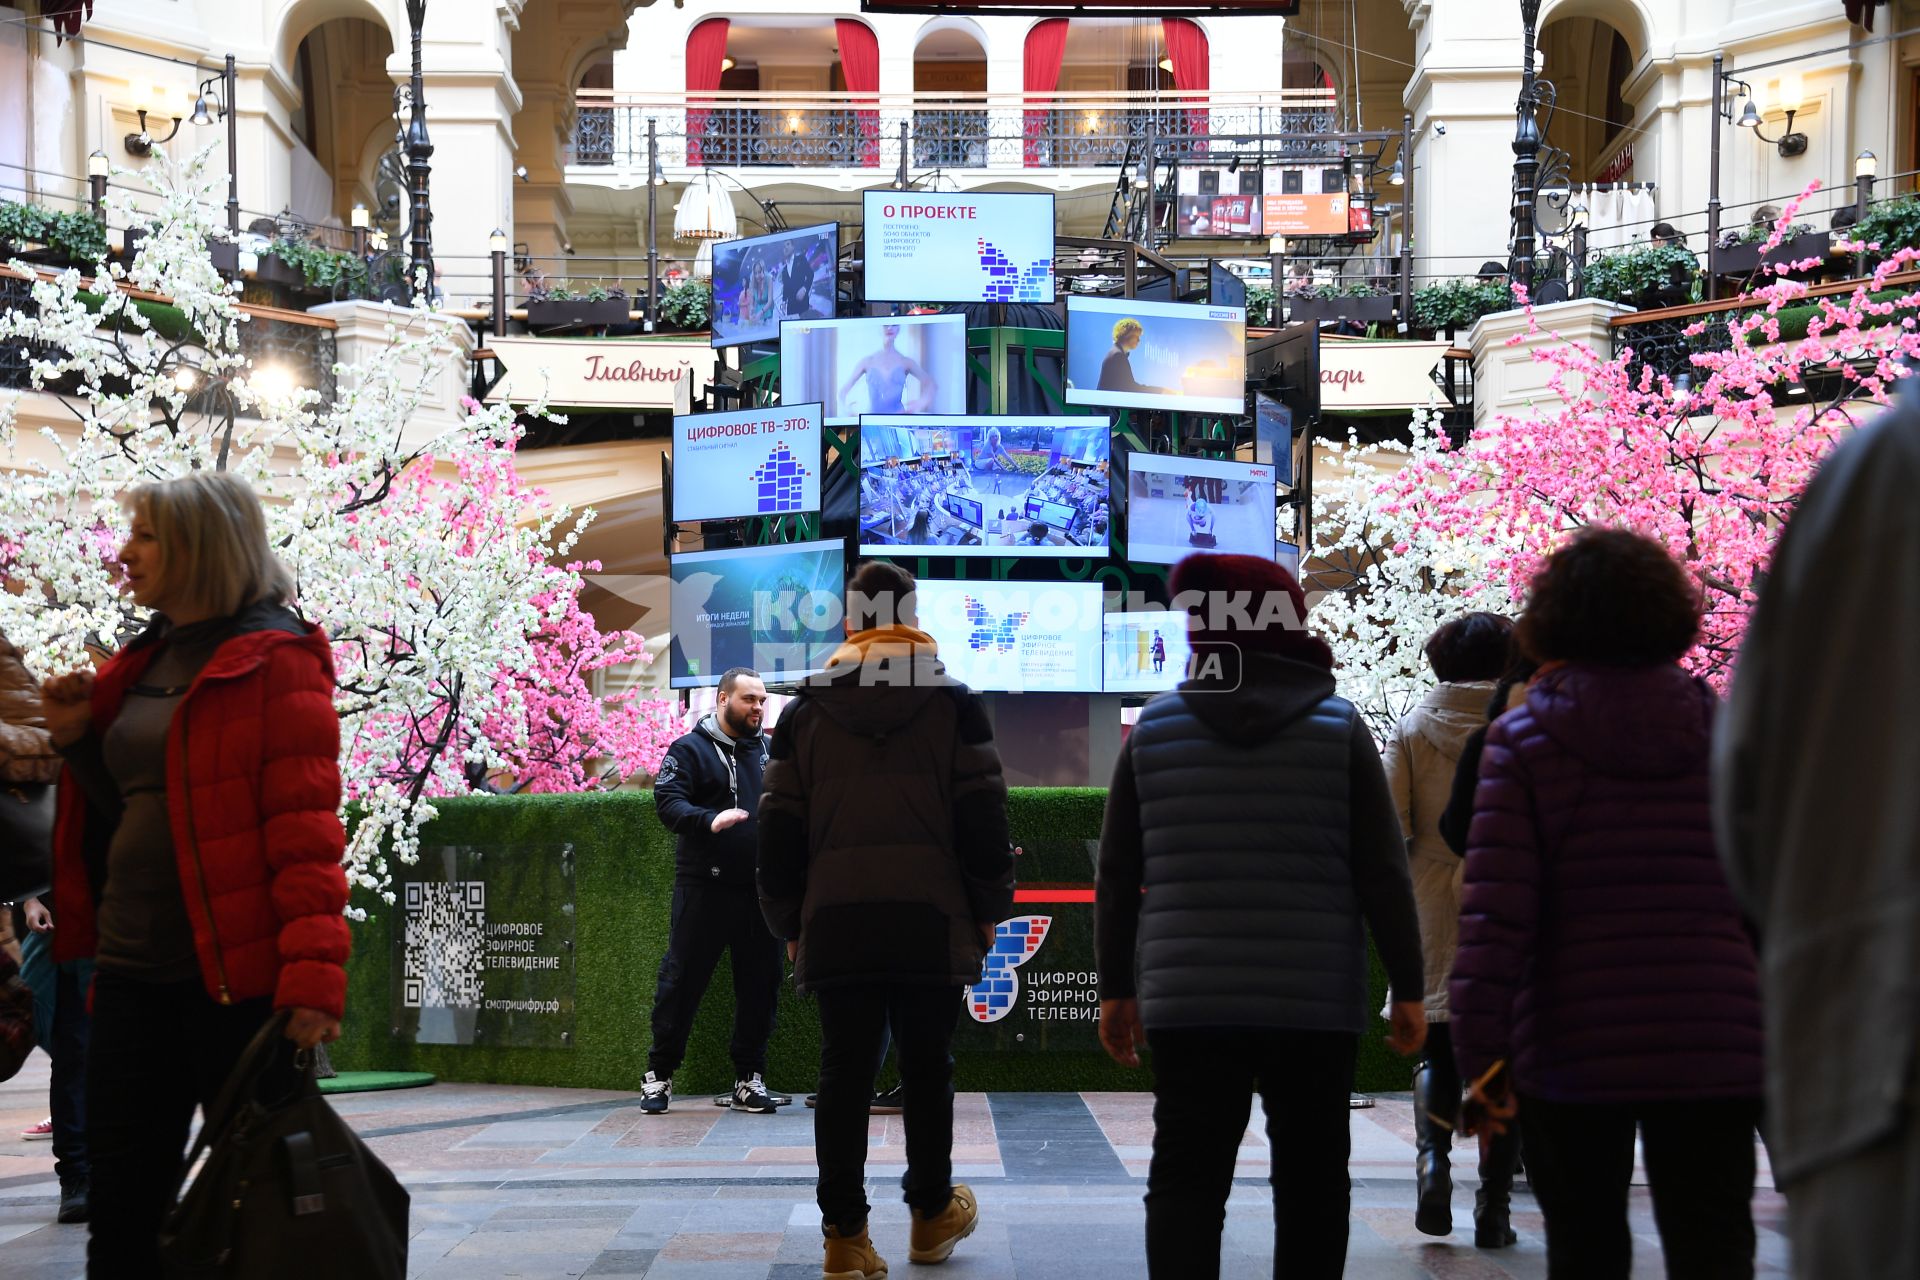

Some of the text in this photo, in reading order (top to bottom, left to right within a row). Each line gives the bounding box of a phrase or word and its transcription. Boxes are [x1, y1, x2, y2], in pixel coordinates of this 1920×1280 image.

[883, 205, 977, 219] О ПРОЕКТЕ
[584, 355, 690, 382] Главный
[1320, 369, 1364, 391] ади
[687, 422, 758, 442] ЦИФРОВОЕ
[696, 611, 750, 622] ИТОГИ НЕДЕЛИ
[1021, 634, 1062, 642] ЦИФРОВОЕ
[486, 923, 543, 936] ЦИФРОВОЕ
[486, 939, 535, 952] ЭФИРНОЕ
[485, 956, 560, 971] ТЕЛЕВИДЕНИЕ
[1027, 972, 1098, 986] ЦИФРОВ
[1027, 989, 1097, 1003] ЭФИРНО
[485, 998, 560, 1013] смотрицифру.рф
[1028, 1007, 1100, 1023] ТЕЛЕВИД
